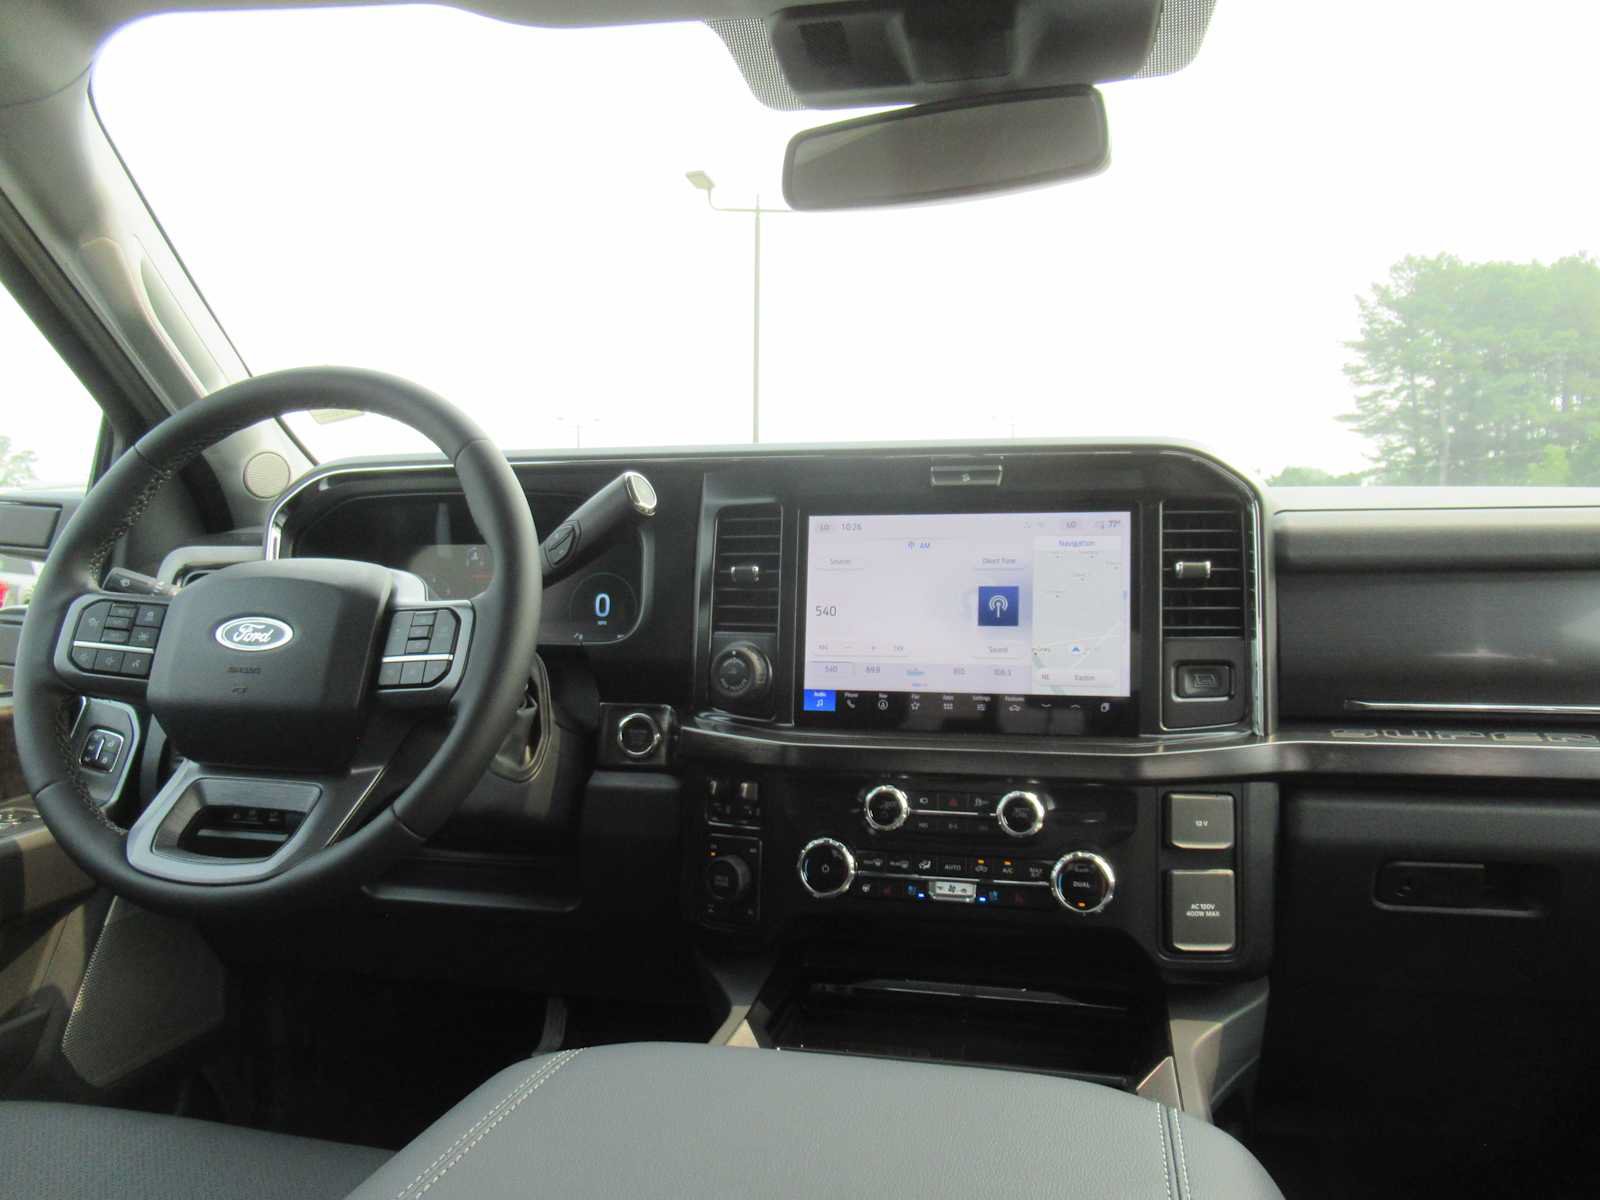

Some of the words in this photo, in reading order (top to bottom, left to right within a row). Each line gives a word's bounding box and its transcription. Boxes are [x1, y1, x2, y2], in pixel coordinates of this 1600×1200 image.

[595, 593, 610, 617] 0
[815, 605, 837, 617] 540
[232, 623, 273, 643] Ford
[944, 863, 962, 872] AUTO
